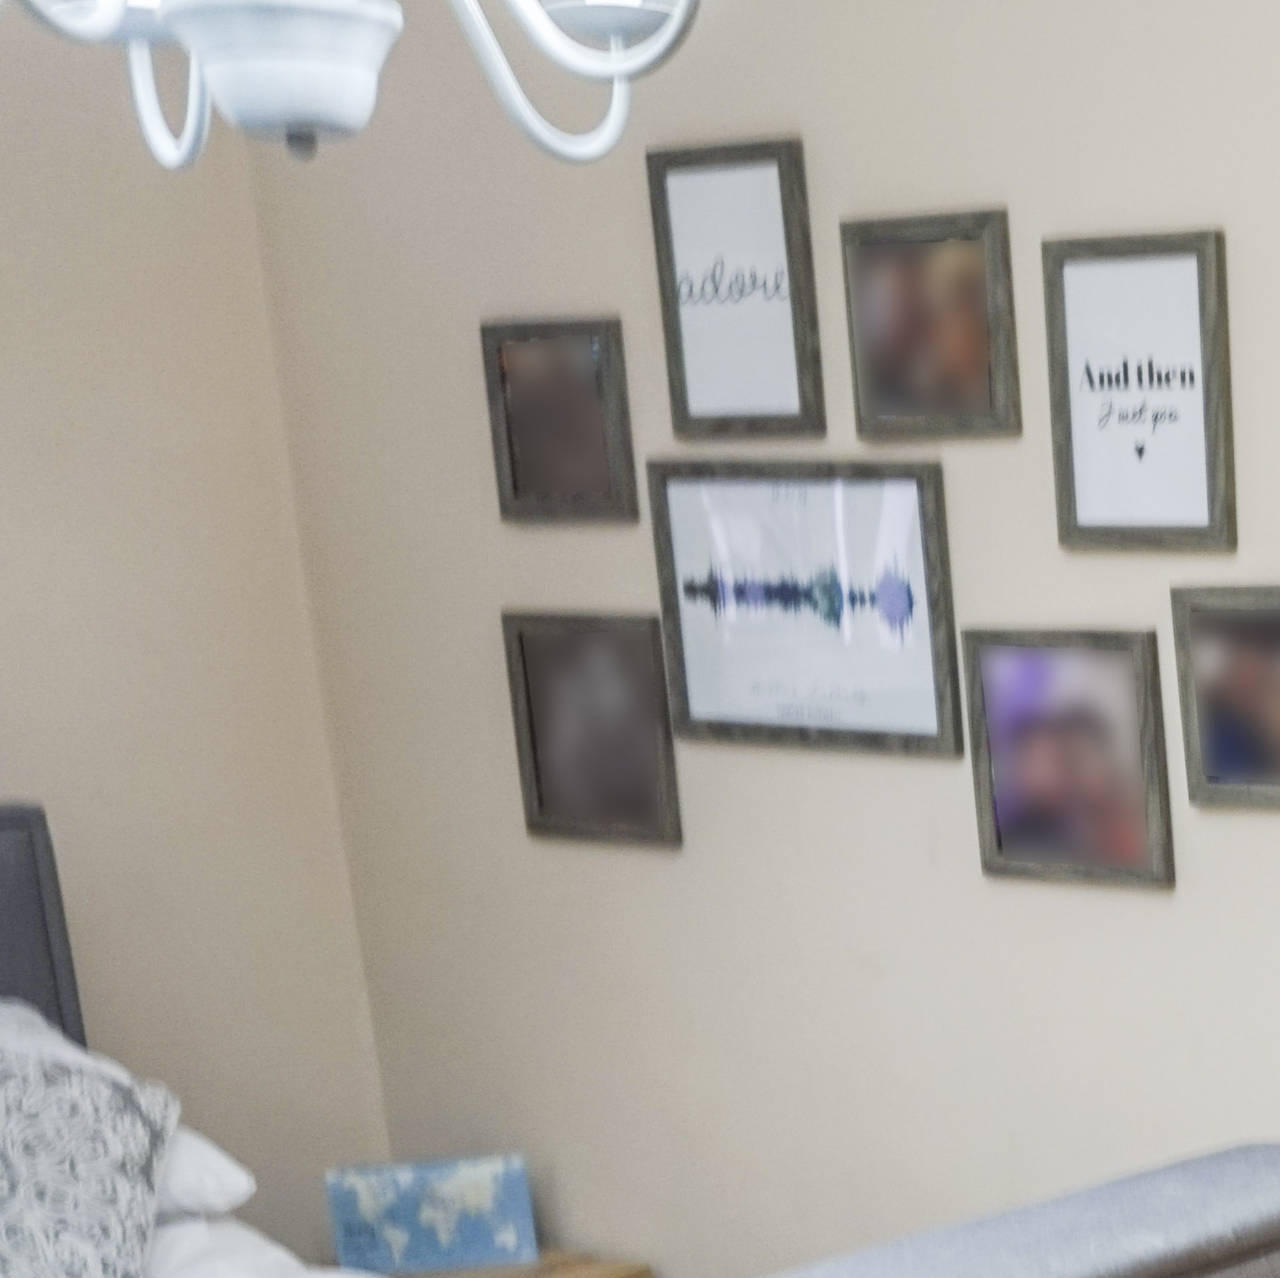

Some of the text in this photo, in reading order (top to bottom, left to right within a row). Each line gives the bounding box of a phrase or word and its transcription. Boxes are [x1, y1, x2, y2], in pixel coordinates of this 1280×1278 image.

[678, 255, 789, 306] adore
[1080, 357, 1195, 392] And then
